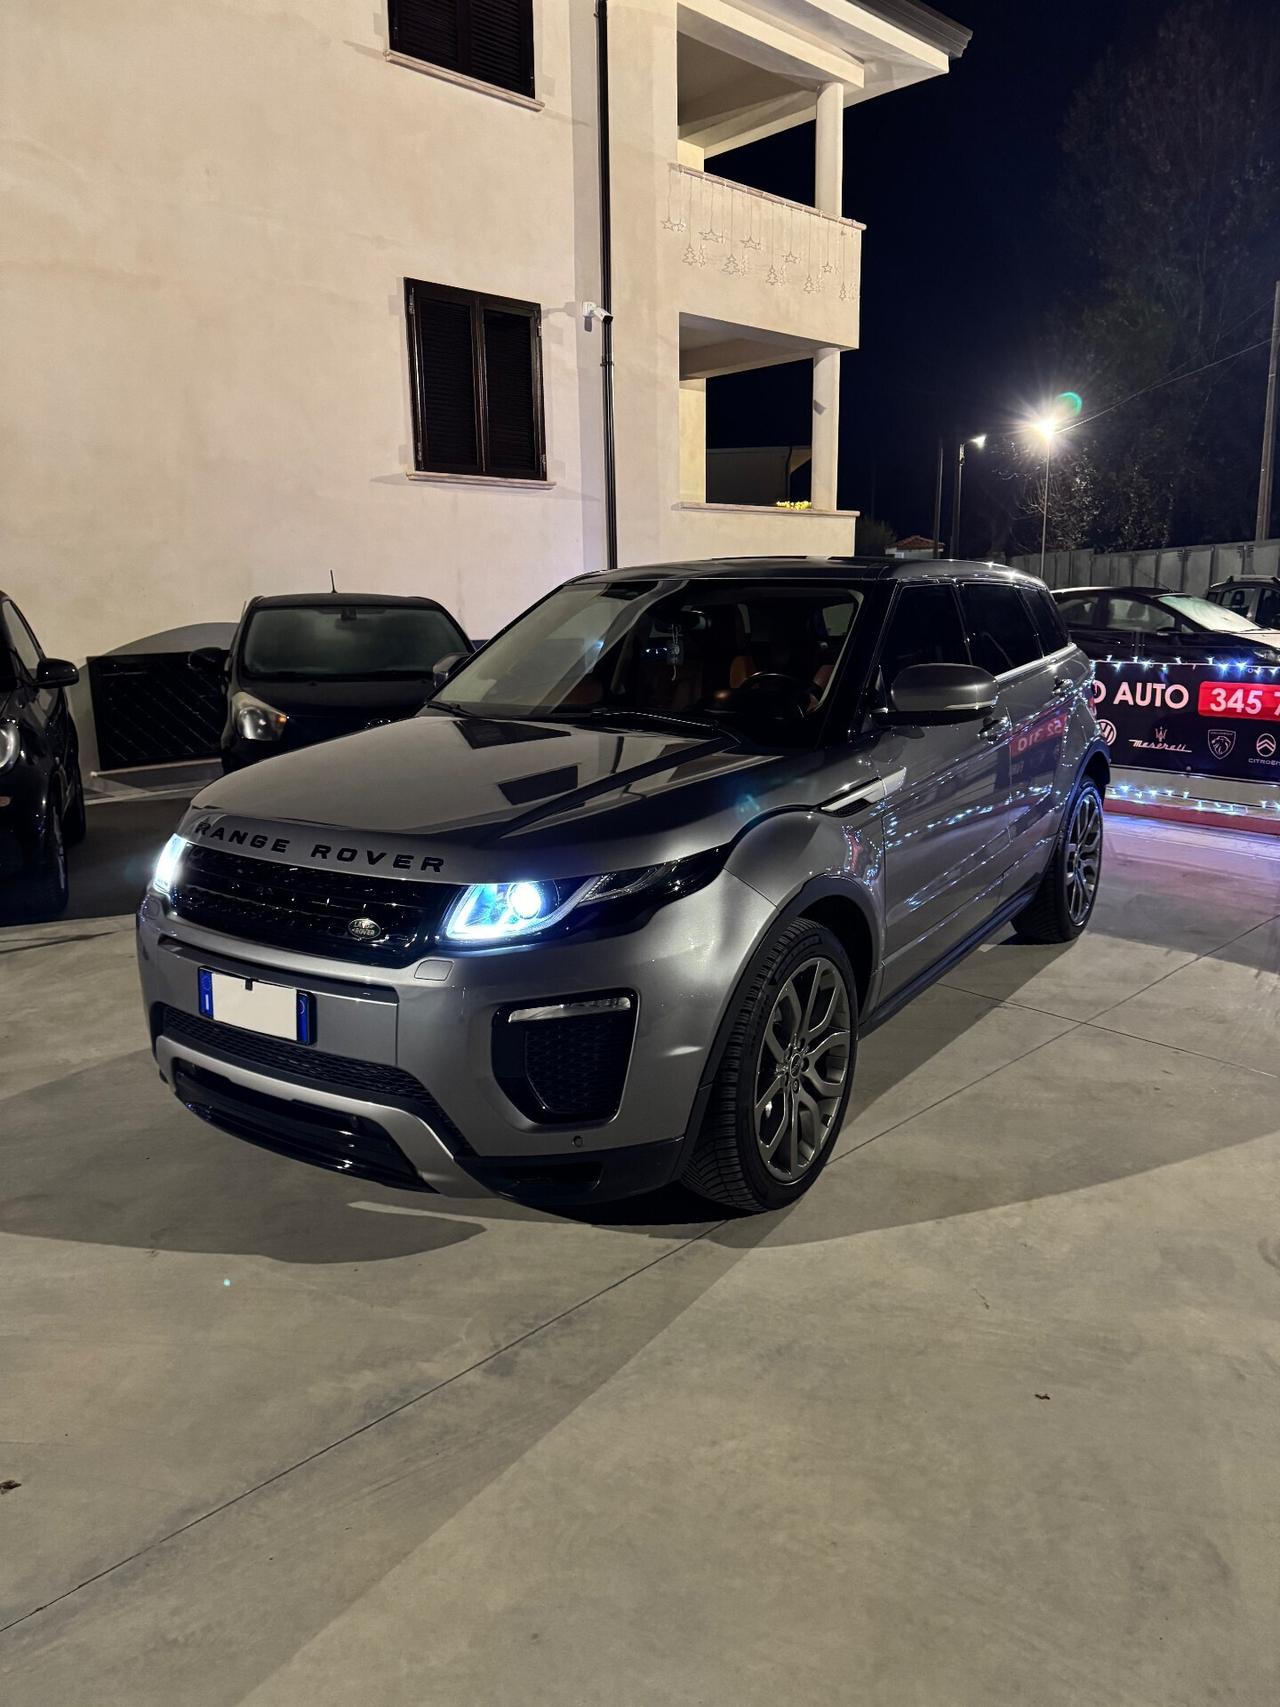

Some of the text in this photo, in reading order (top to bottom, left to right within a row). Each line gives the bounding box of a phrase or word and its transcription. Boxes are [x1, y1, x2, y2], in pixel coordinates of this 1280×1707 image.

[1113, 681, 1189, 710] AUTO
[1210, 687, 1263, 715] 345
[195, 822, 444, 873] RANGE ROVER
